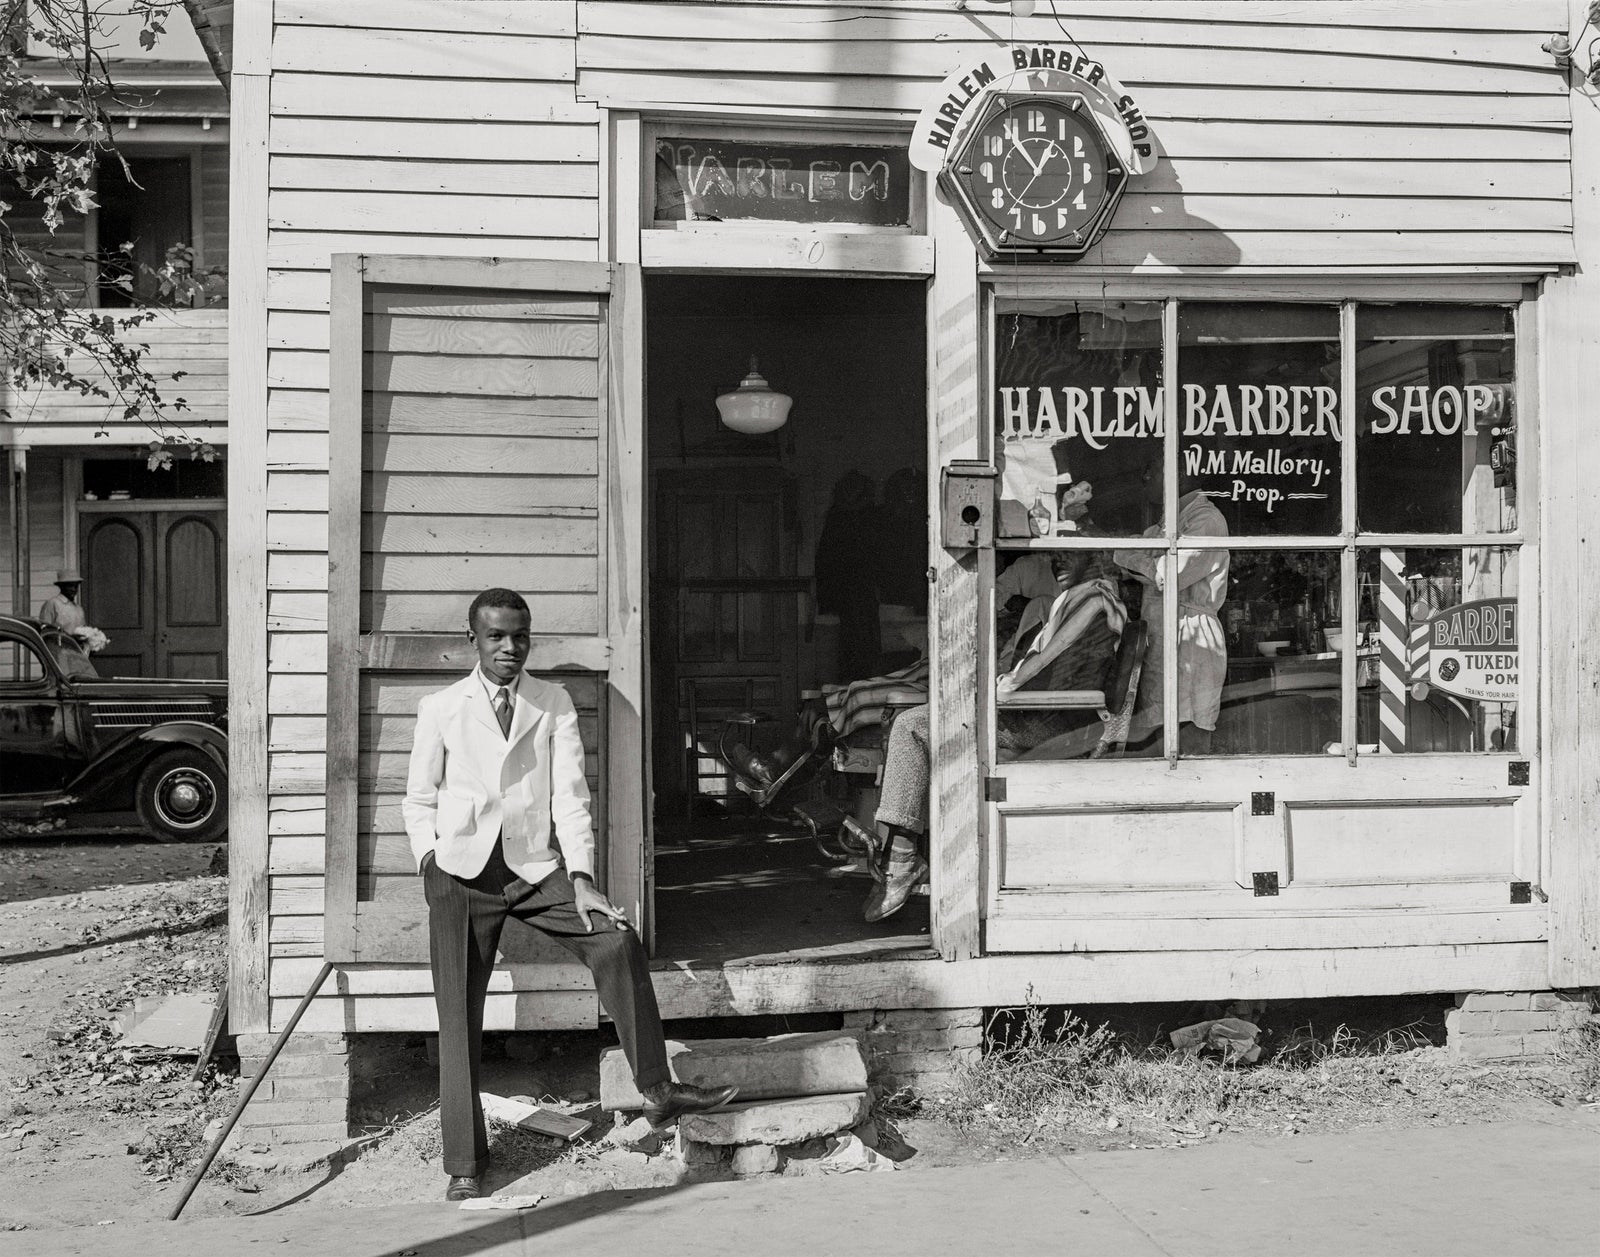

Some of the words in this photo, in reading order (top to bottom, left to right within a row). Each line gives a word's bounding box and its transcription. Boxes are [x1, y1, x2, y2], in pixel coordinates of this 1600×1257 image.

[927, 62, 997, 150] HARLEM
[1012, 48, 1104, 87] BARBER
[1113, 95, 1151, 158] SHOP
[1028, 110, 1046, 132] 12
[983, 135, 1003, 156] 10
[1074, 136, 1085, 157] 2
[979, 162, 993, 183] 9
[1083, 162, 1092, 184] 3
[991, 187, 1004, 209] 8
[1072, 189, 1087, 210] 4
[1032, 213, 1046, 235] 6
[1057, 208, 1068, 229] 5
[999, 385, 1165, 450] HARLEM
[1182, 383, 1342, 442] BARBER
[1230, 449, 1331, 487] Mallory.
[1231, 480, 1285, 513] Prop.
[1465, 655, 1518, 669] TUXED
[1465, 687, 1484, 697] TRAINS
